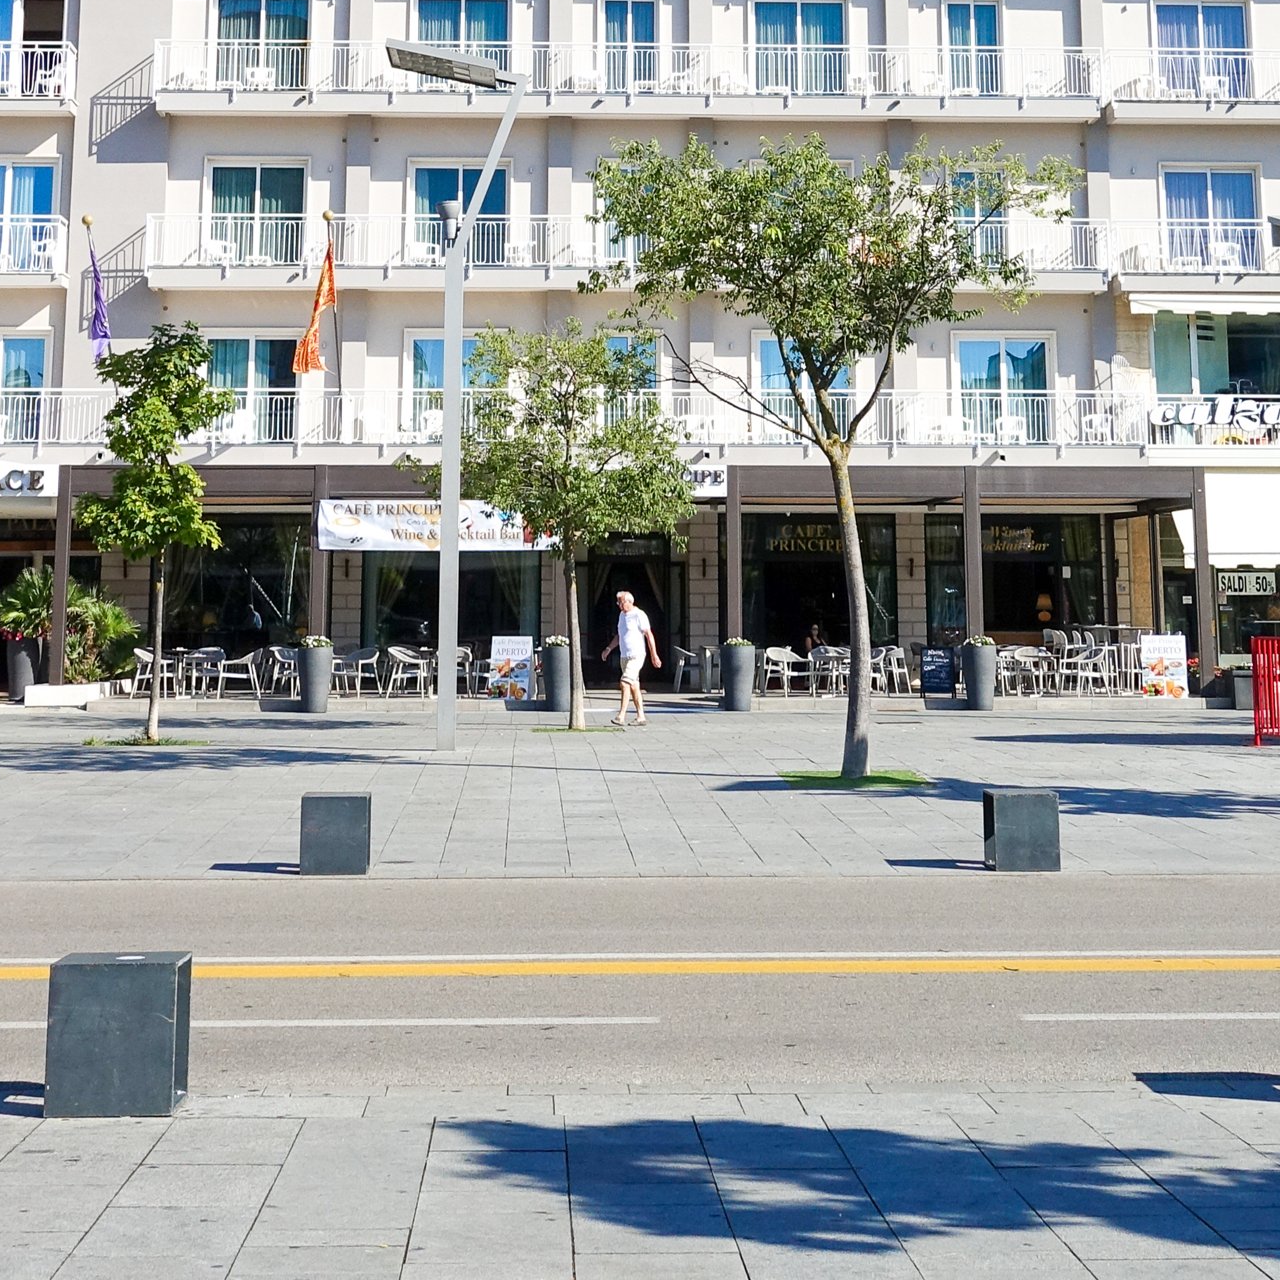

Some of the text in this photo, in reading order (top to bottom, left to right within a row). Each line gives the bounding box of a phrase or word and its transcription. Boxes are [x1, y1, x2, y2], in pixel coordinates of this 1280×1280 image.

[391, 528, 425, 541] Wine
[427, 528, 439, 541] &
[500, 529, 521, 540] Bar
[1220, 575, 1247, 593] SALDI
[495, 648, 528, 656] APERTO
[1146, 646, 1182, 655] APERTO
